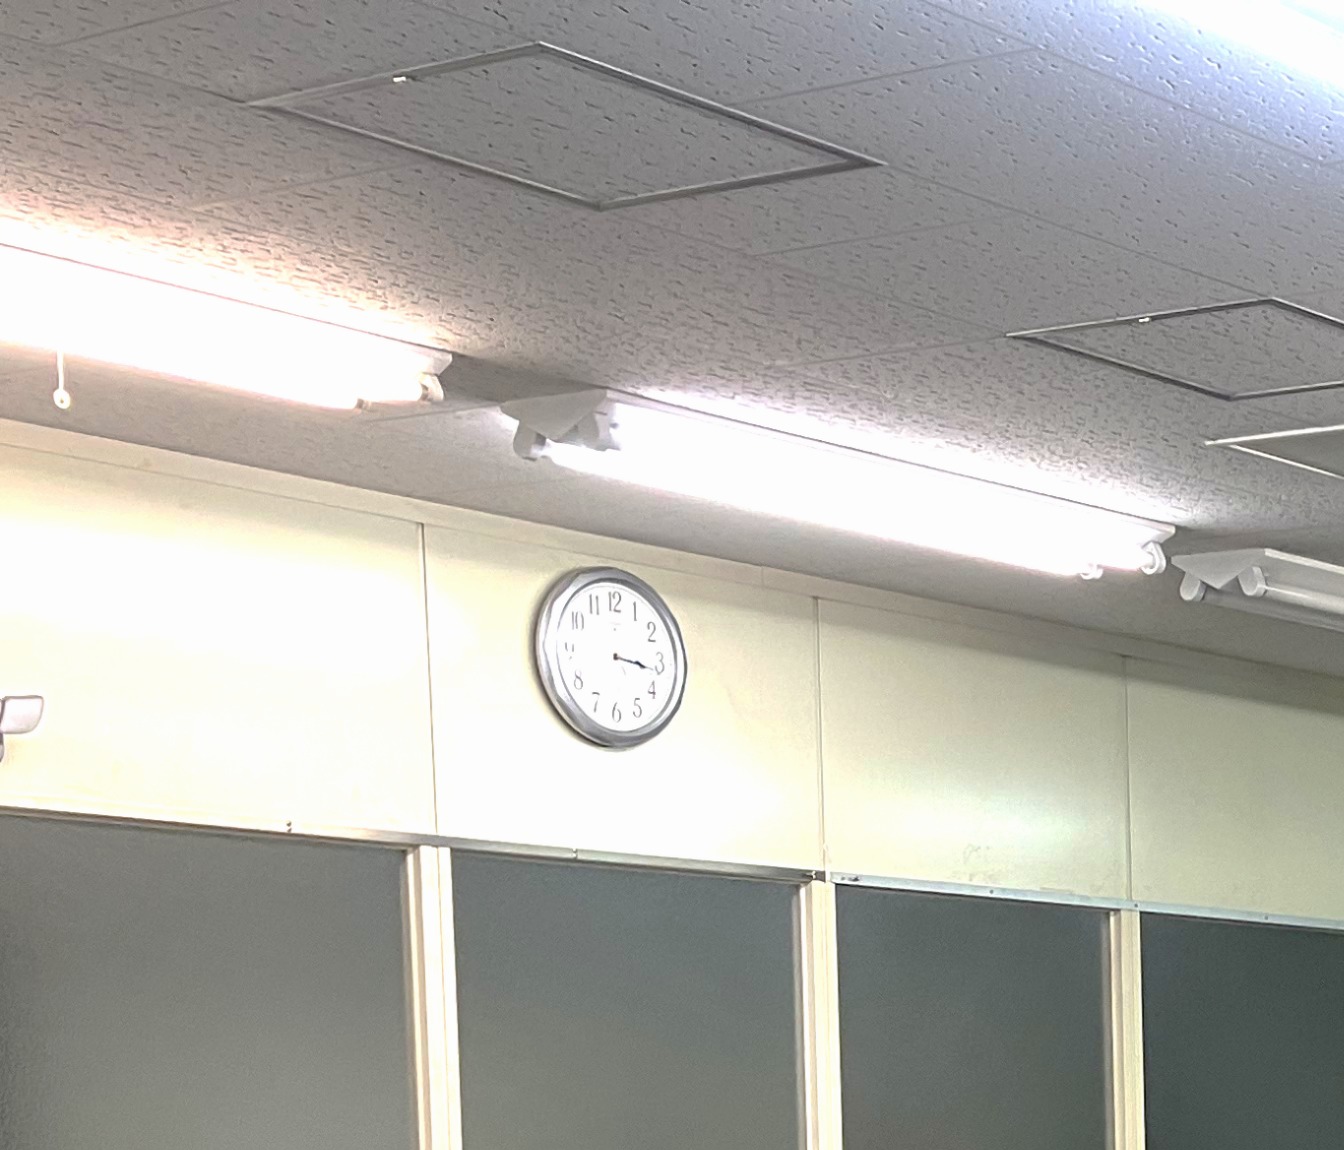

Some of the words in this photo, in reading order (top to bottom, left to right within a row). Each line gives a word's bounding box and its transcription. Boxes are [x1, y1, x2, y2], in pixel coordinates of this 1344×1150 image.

[588, 594, 600, 615] 11
[608, 591, 622, 613] 12
[632, 601, 638, 622] 1
[571, 611, 585, 631] 10
[647, 622, 657, 643] 2
[654, 652, 666, 676] 3
[573, 670, 584, 690] 8
[647, 680, 657, 700] 4
[591, 692, 600, 713] 7
[611, 702, 622, 723] 6
[632, 698, 643, 719] 5
